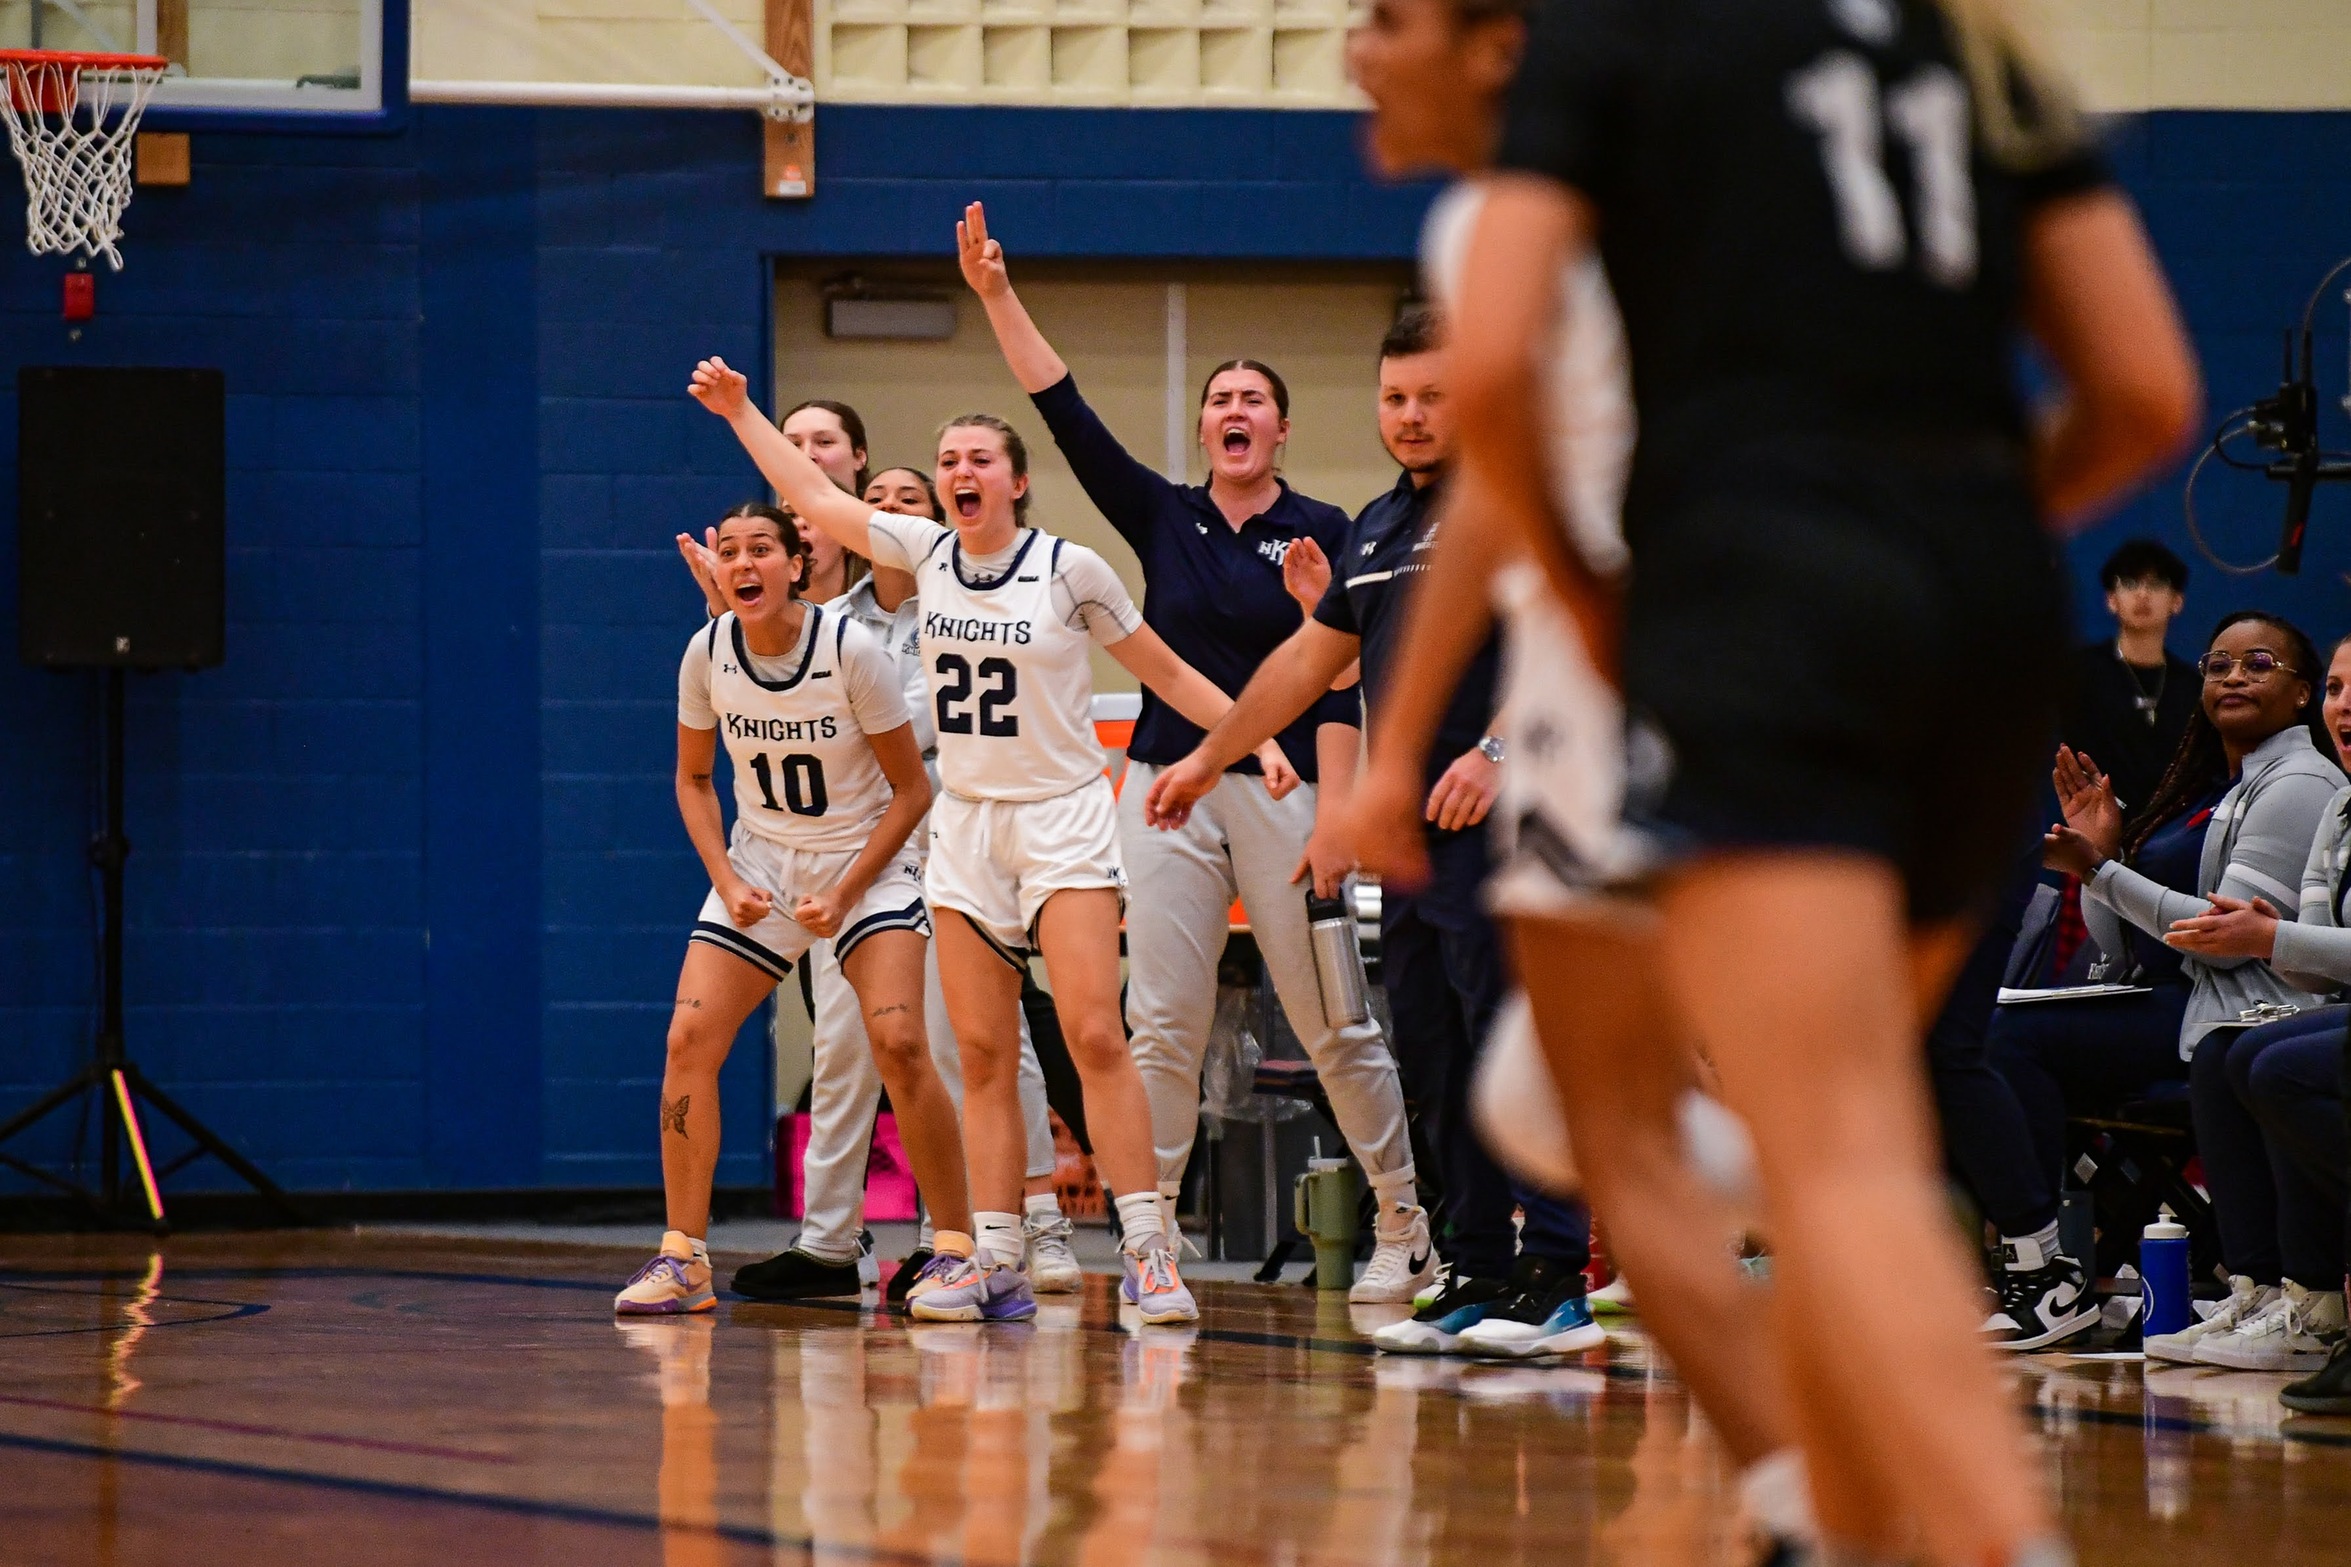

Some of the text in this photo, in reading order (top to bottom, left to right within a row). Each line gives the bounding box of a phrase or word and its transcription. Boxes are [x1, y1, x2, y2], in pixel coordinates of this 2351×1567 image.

[1783, 52, 1978, 284] 11
[924, 611, 1032, 646] KNIGHTS
[726, 712, 837, 743] KNIGHTS
[935, 652, 1020, 737] 22
[749, 752, 829, 818] 10
